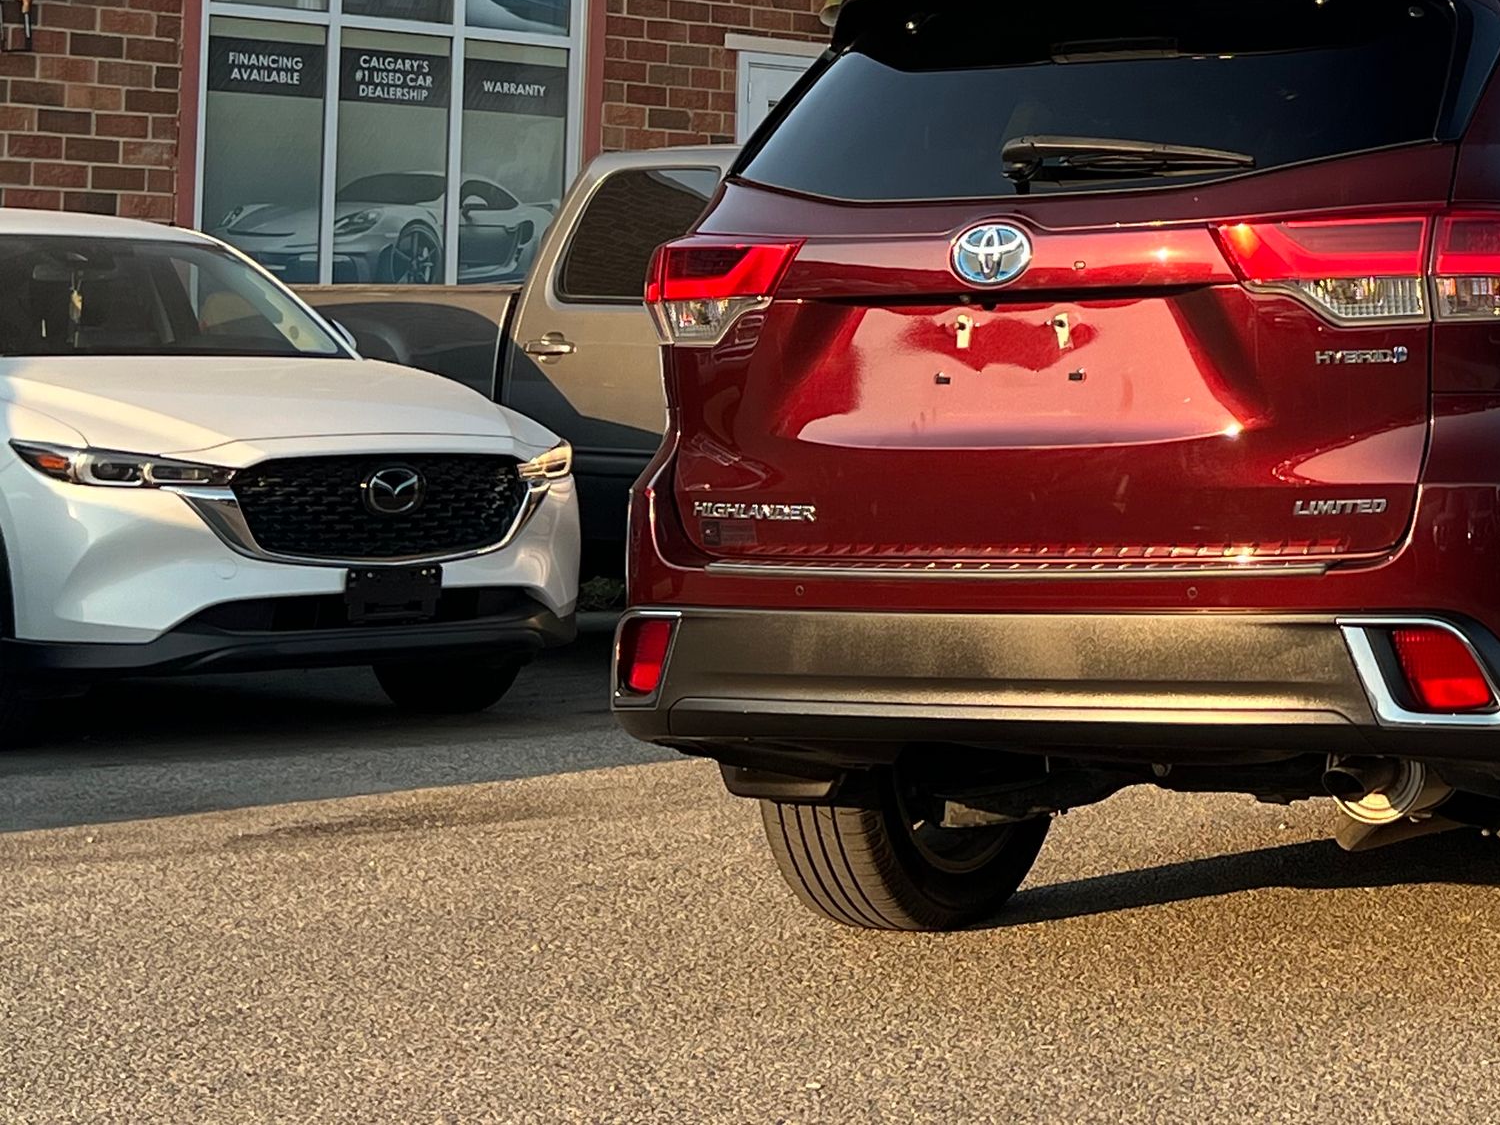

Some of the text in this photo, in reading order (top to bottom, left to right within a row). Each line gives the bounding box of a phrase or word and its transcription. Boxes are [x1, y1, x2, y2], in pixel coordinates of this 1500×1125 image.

[228, 52, 303, 70] FINANCING
[360, 55, 429, 73] CALGARY'S
[230, 68, 300, 85] AVAILABLE
[355, 69, 433, 88] #1 USED CAR
[359, 85, 429, 101] DEALERSHIP
[482, 80, 546, 97] WARRANTY
[1315, 349, 1393, 365] HYBRID
[693, 501, 817, 522] HIGHLANDER
[1293, 498, 1387, 515] LIMITED
